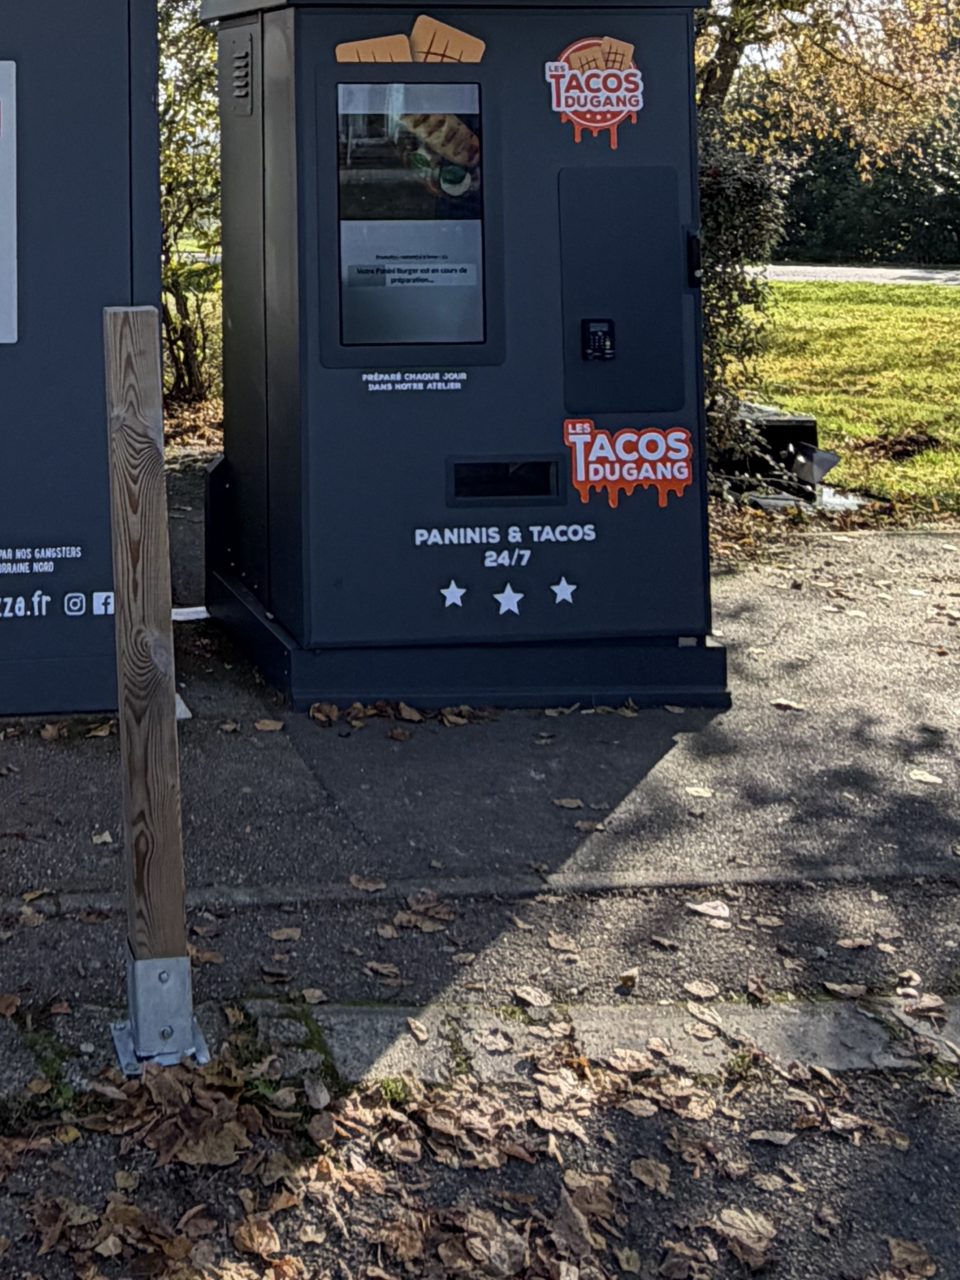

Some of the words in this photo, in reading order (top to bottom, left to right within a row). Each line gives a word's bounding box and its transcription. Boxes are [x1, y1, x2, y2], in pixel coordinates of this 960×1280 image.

[548, 64, 566, 72] LES
[549, 72, 641, 108] TACOS
[403, 372, 441, 381] CHAQUE
[442, 372, 468, 380] JOUR
[367, 383, 393, 391] DANS
[426, 382, 462, 390] ATELIER
[568, 423, 591, 433] LES
[568, 431, 690, 482] TACOS
[415, 525, 501, 546] PANINIS
[507, 526, 523, 544] &
[529, 523, 597, 542] TACOS
[15, 547, 32, 560] NOS
[34, 545, 82, 559] GANGSTERS
[484, 549, 532, 568] 24/7
[32, 560, 55, 574] NORD
